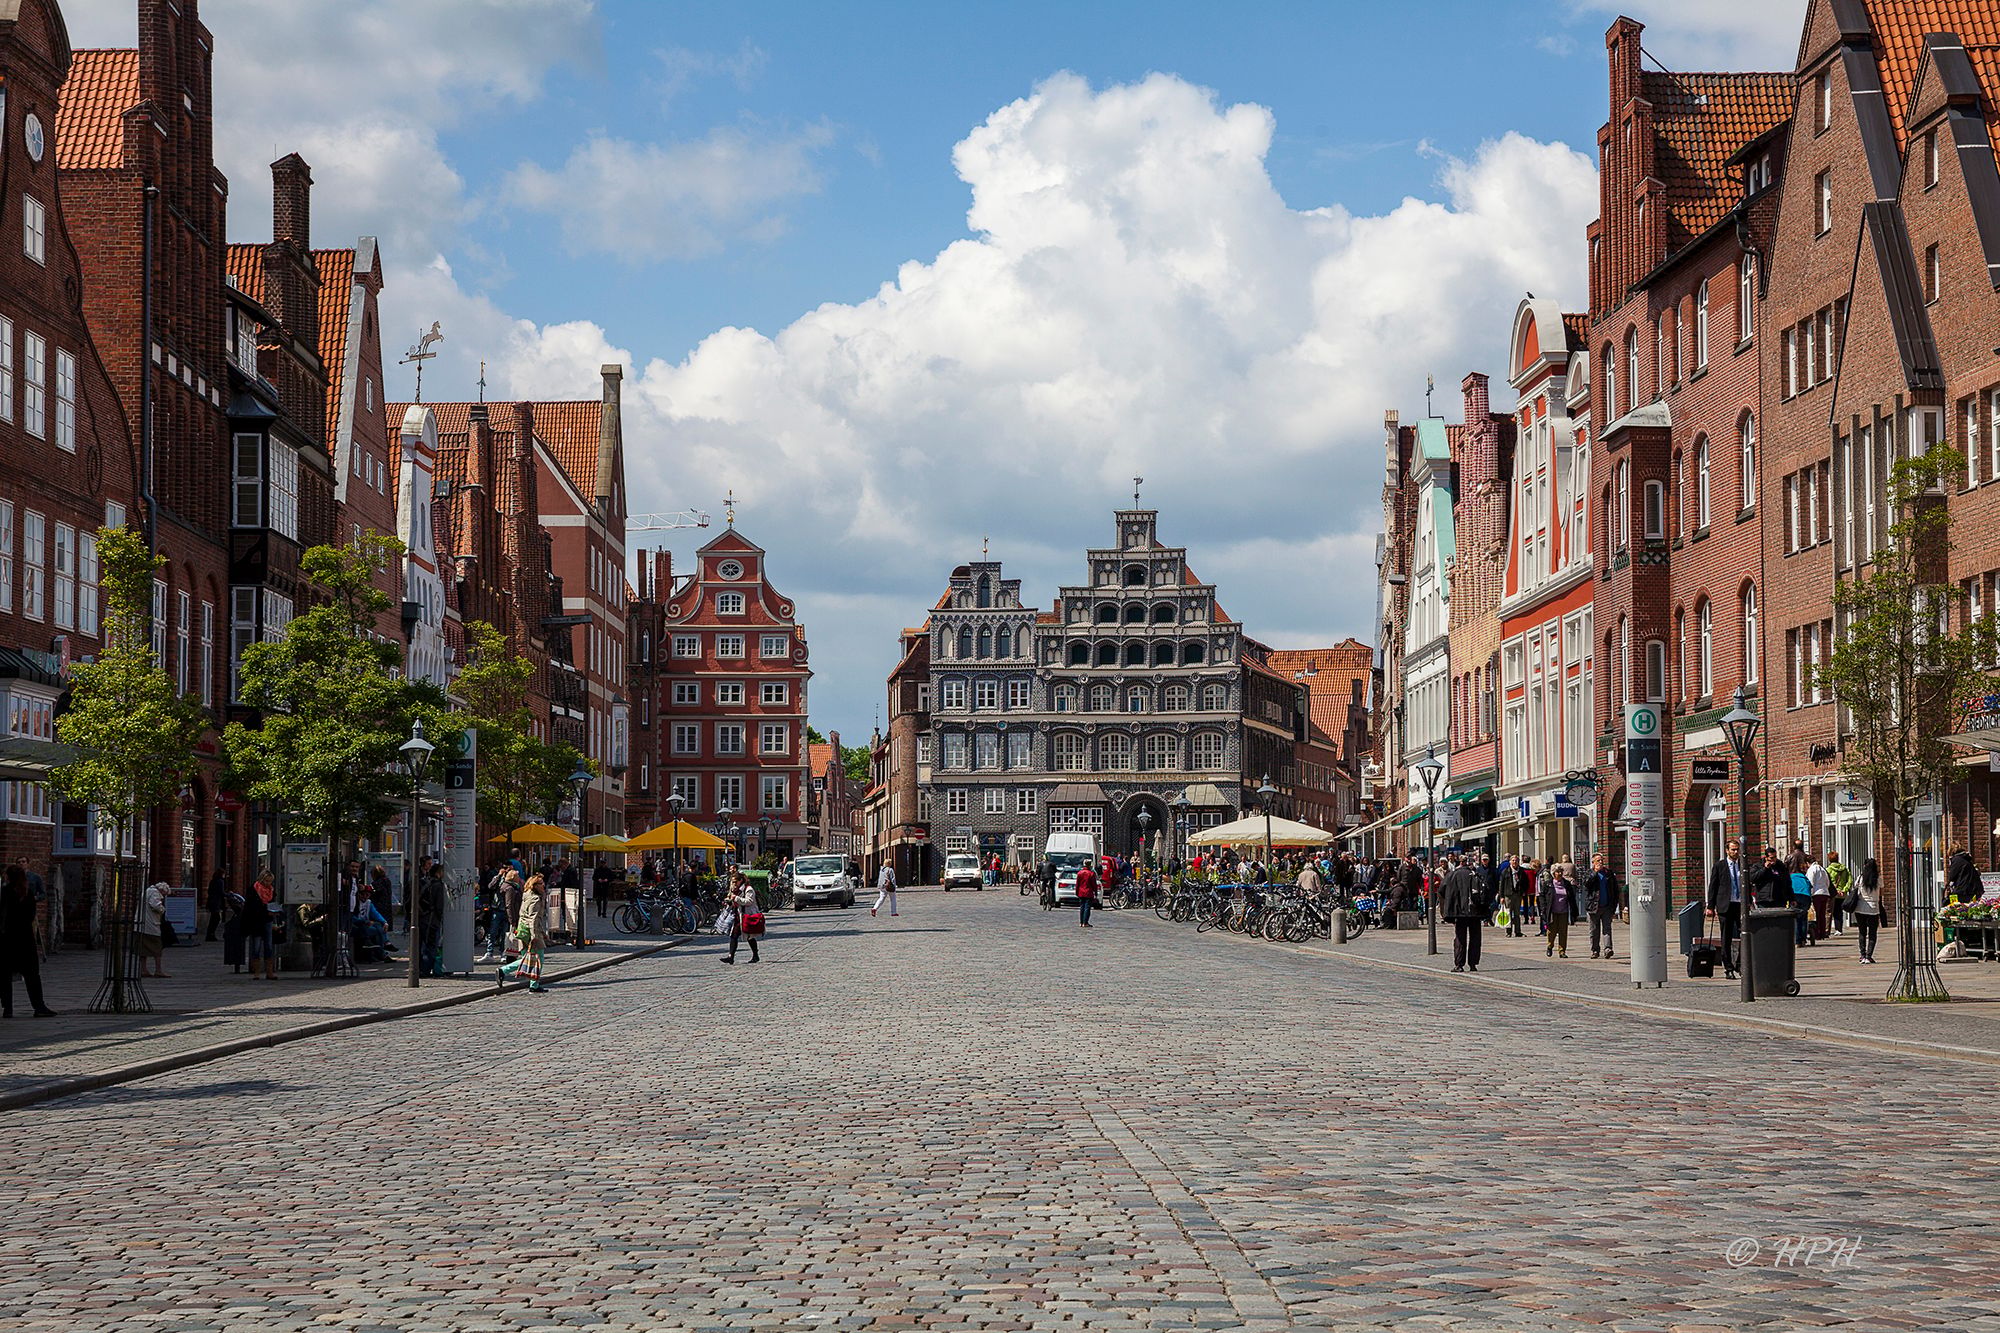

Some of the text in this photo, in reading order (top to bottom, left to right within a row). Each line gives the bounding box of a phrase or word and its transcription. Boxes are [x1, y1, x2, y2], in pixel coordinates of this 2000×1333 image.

[1640, 758, 1650, 771] A
[454, 775, 463, 787] D
[1436, 805, 1448, 813] WC
